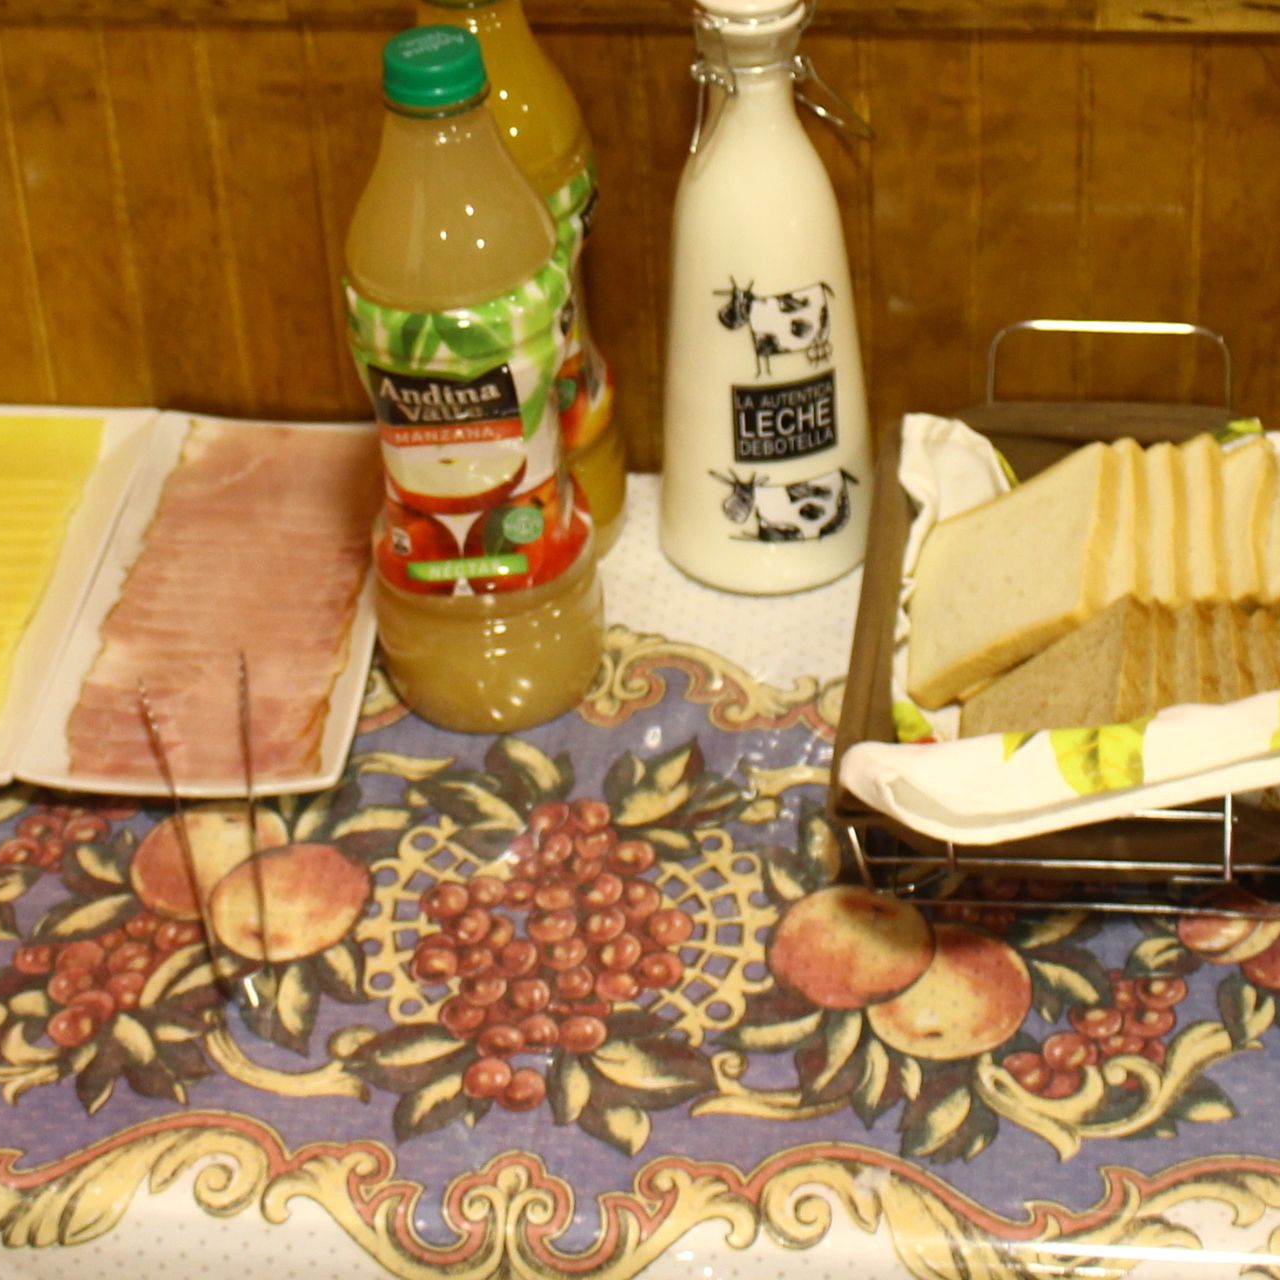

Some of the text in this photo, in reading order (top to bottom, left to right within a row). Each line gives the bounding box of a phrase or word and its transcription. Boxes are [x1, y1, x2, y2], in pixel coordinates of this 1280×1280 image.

[380, 376, 501, 406] Andina
[736, 395, 754, 409] LA
[740, 398, 832, 438] LECHE
[394, 426, 495, 444] MANZANA
